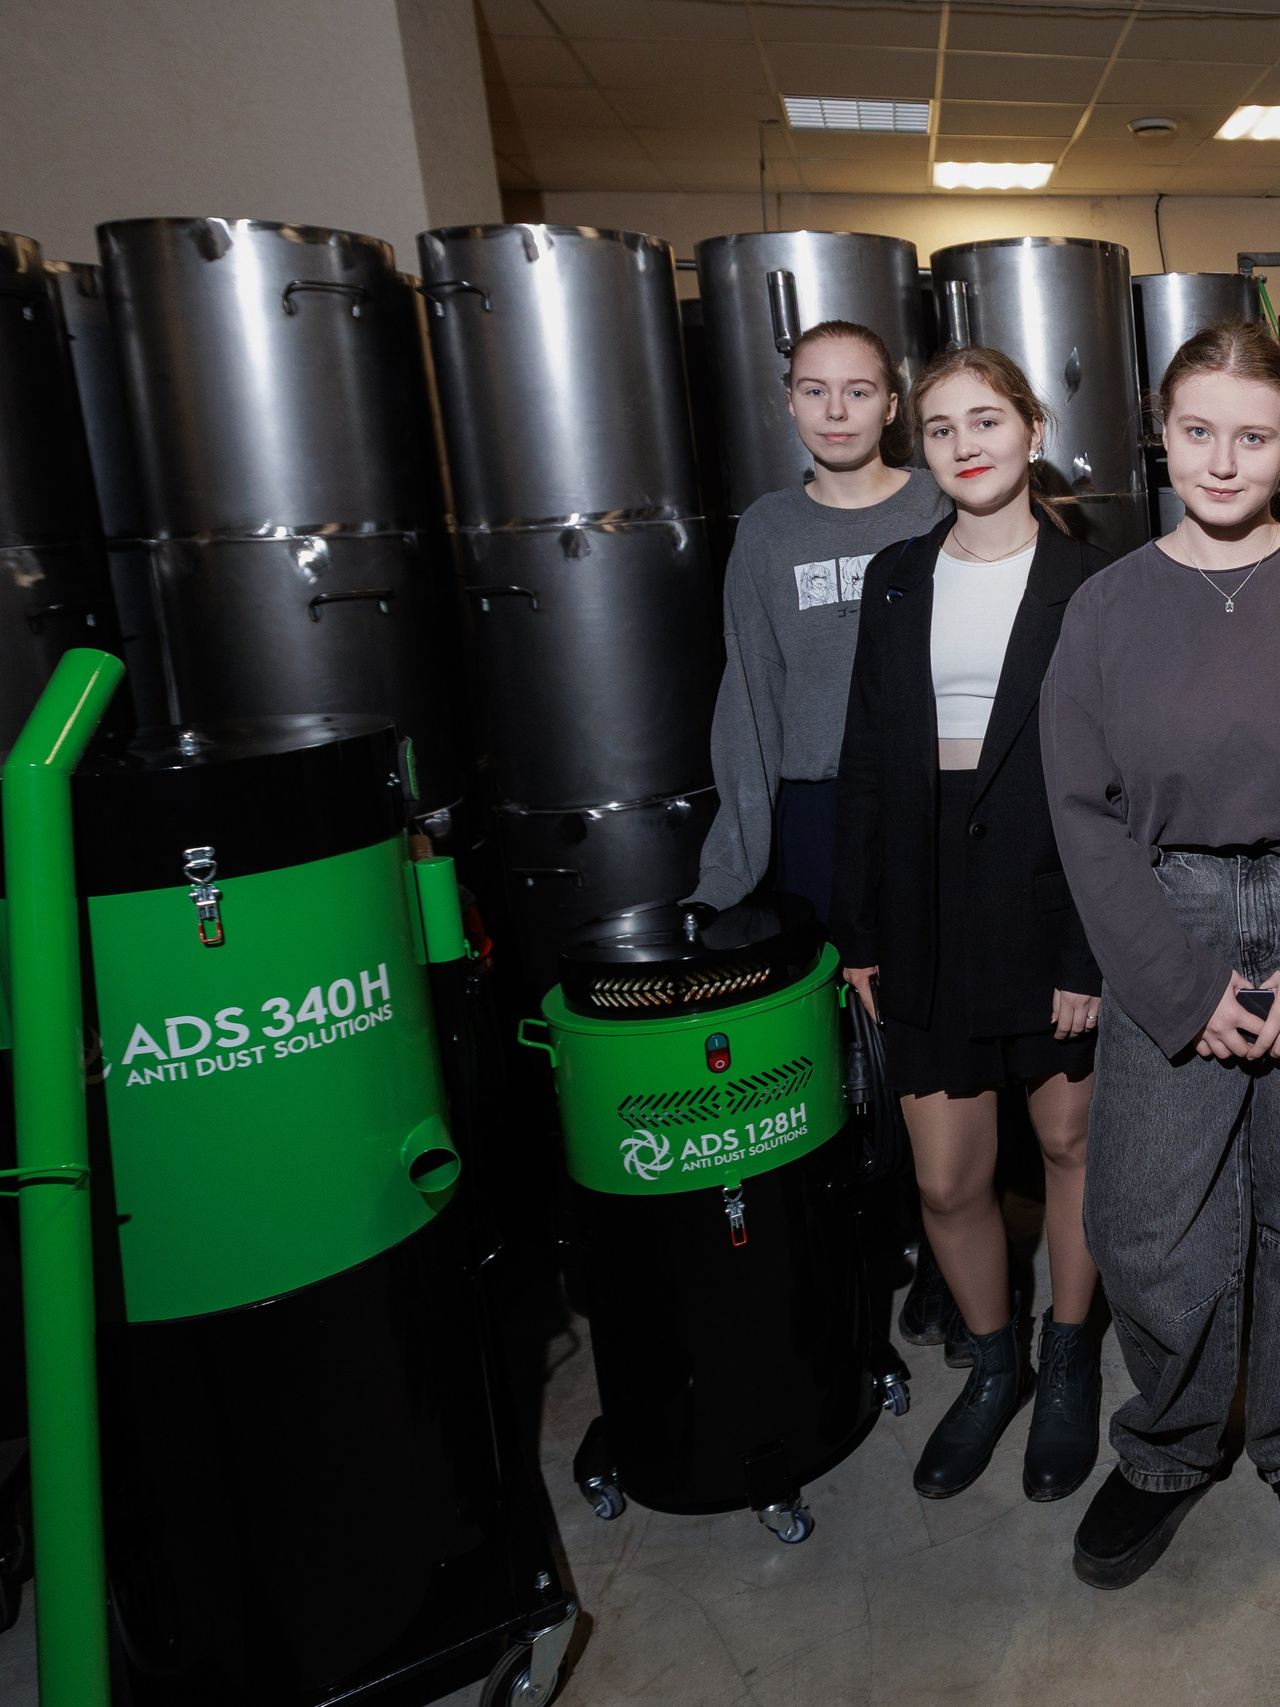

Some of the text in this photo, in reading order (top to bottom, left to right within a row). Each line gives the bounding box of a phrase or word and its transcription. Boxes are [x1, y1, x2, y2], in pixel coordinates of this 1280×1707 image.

[837, 606, 861, 619] ゴー
[121, 962, 391, 1066] ADS 340H
[125, 1003, 393, 1087] ANTI DUST SOLUTIONS
[680, 1102, 807, 1160] ADS 128H
[681, 1125, 808, 1172] ANTI DUST SOLUTIONS
